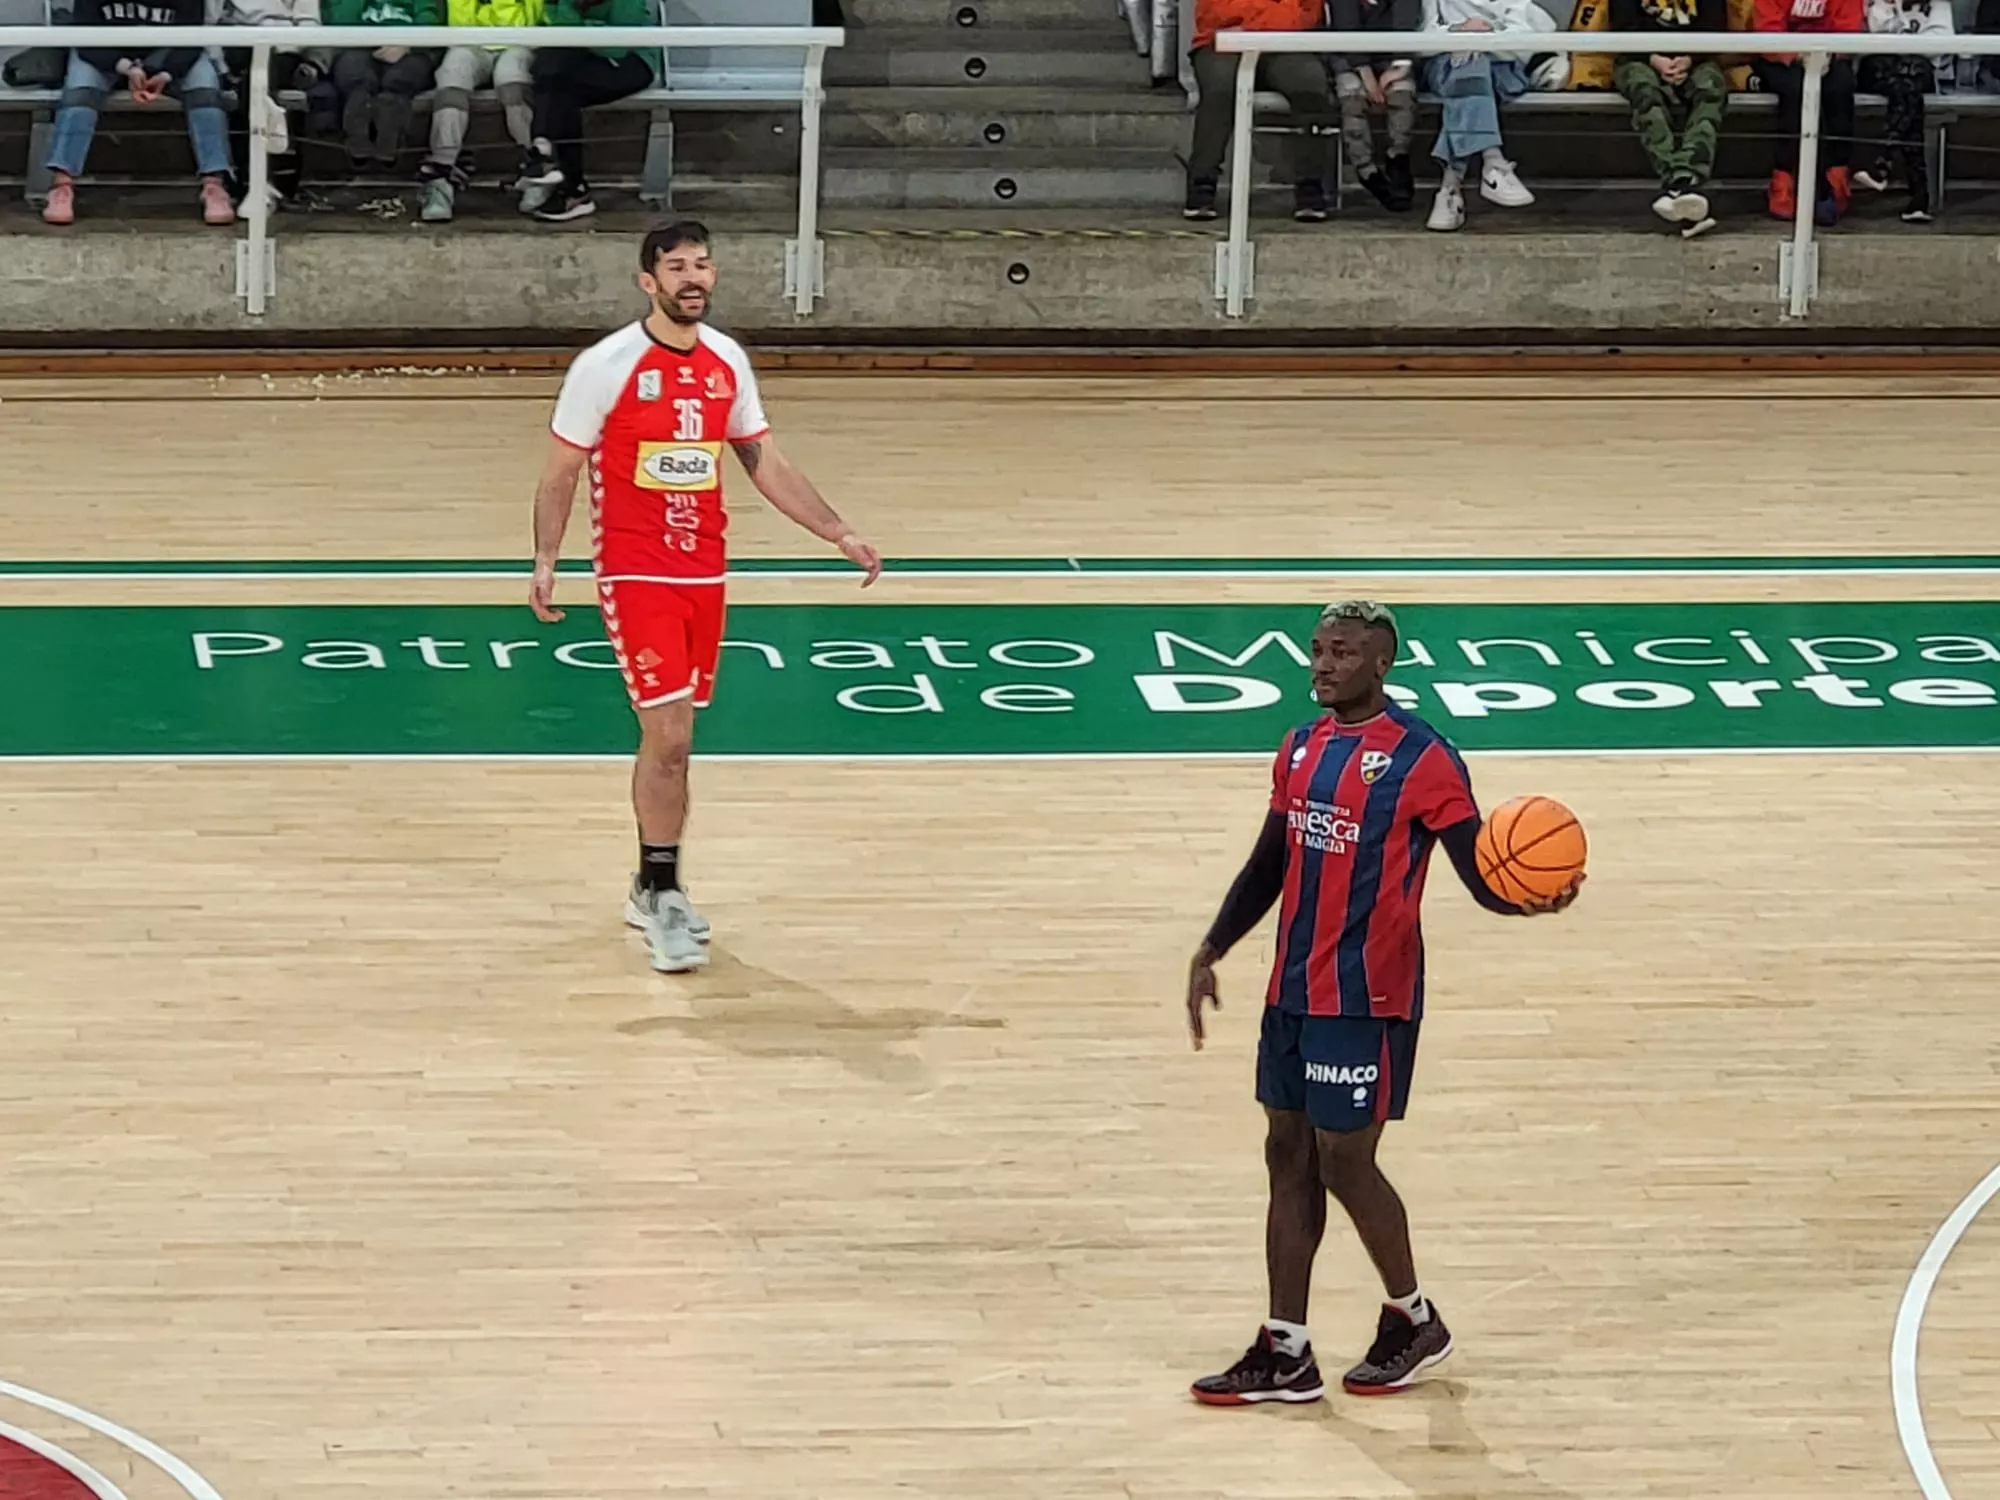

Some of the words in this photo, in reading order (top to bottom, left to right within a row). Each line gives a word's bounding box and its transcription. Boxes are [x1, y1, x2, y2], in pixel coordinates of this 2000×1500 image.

[672, 398, 704, 440] 36
[659, 455, 709, 475] Bada
[836, 673, 1076, 714] de
[1132, 673, 1999, 718] Dporte
